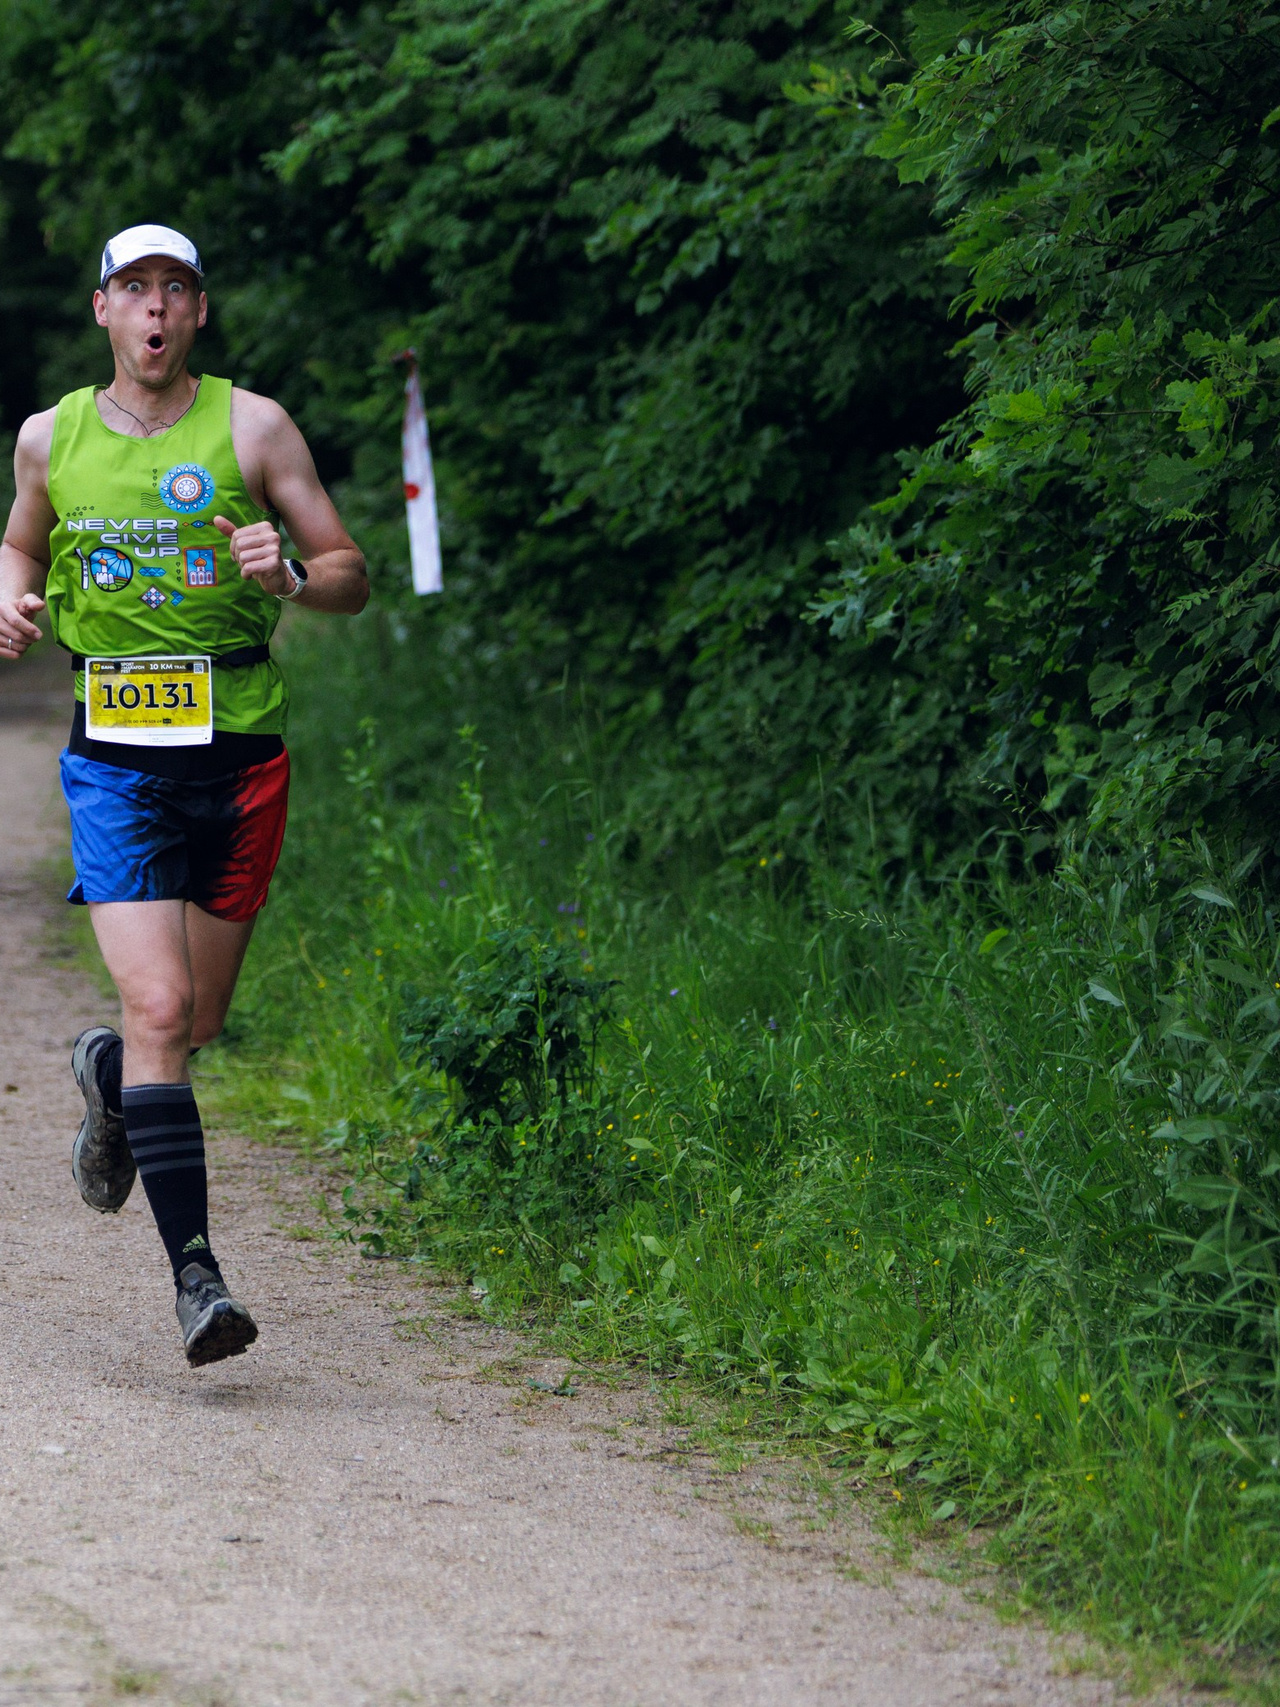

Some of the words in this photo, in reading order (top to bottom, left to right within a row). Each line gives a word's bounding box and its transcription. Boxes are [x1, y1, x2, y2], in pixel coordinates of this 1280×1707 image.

[66, 518, 179, 532] NEVER
[99, 532, 179, 545] GIVE
[133, 546, 181, 558] UP
[102, 683, 198, 709] 10131
